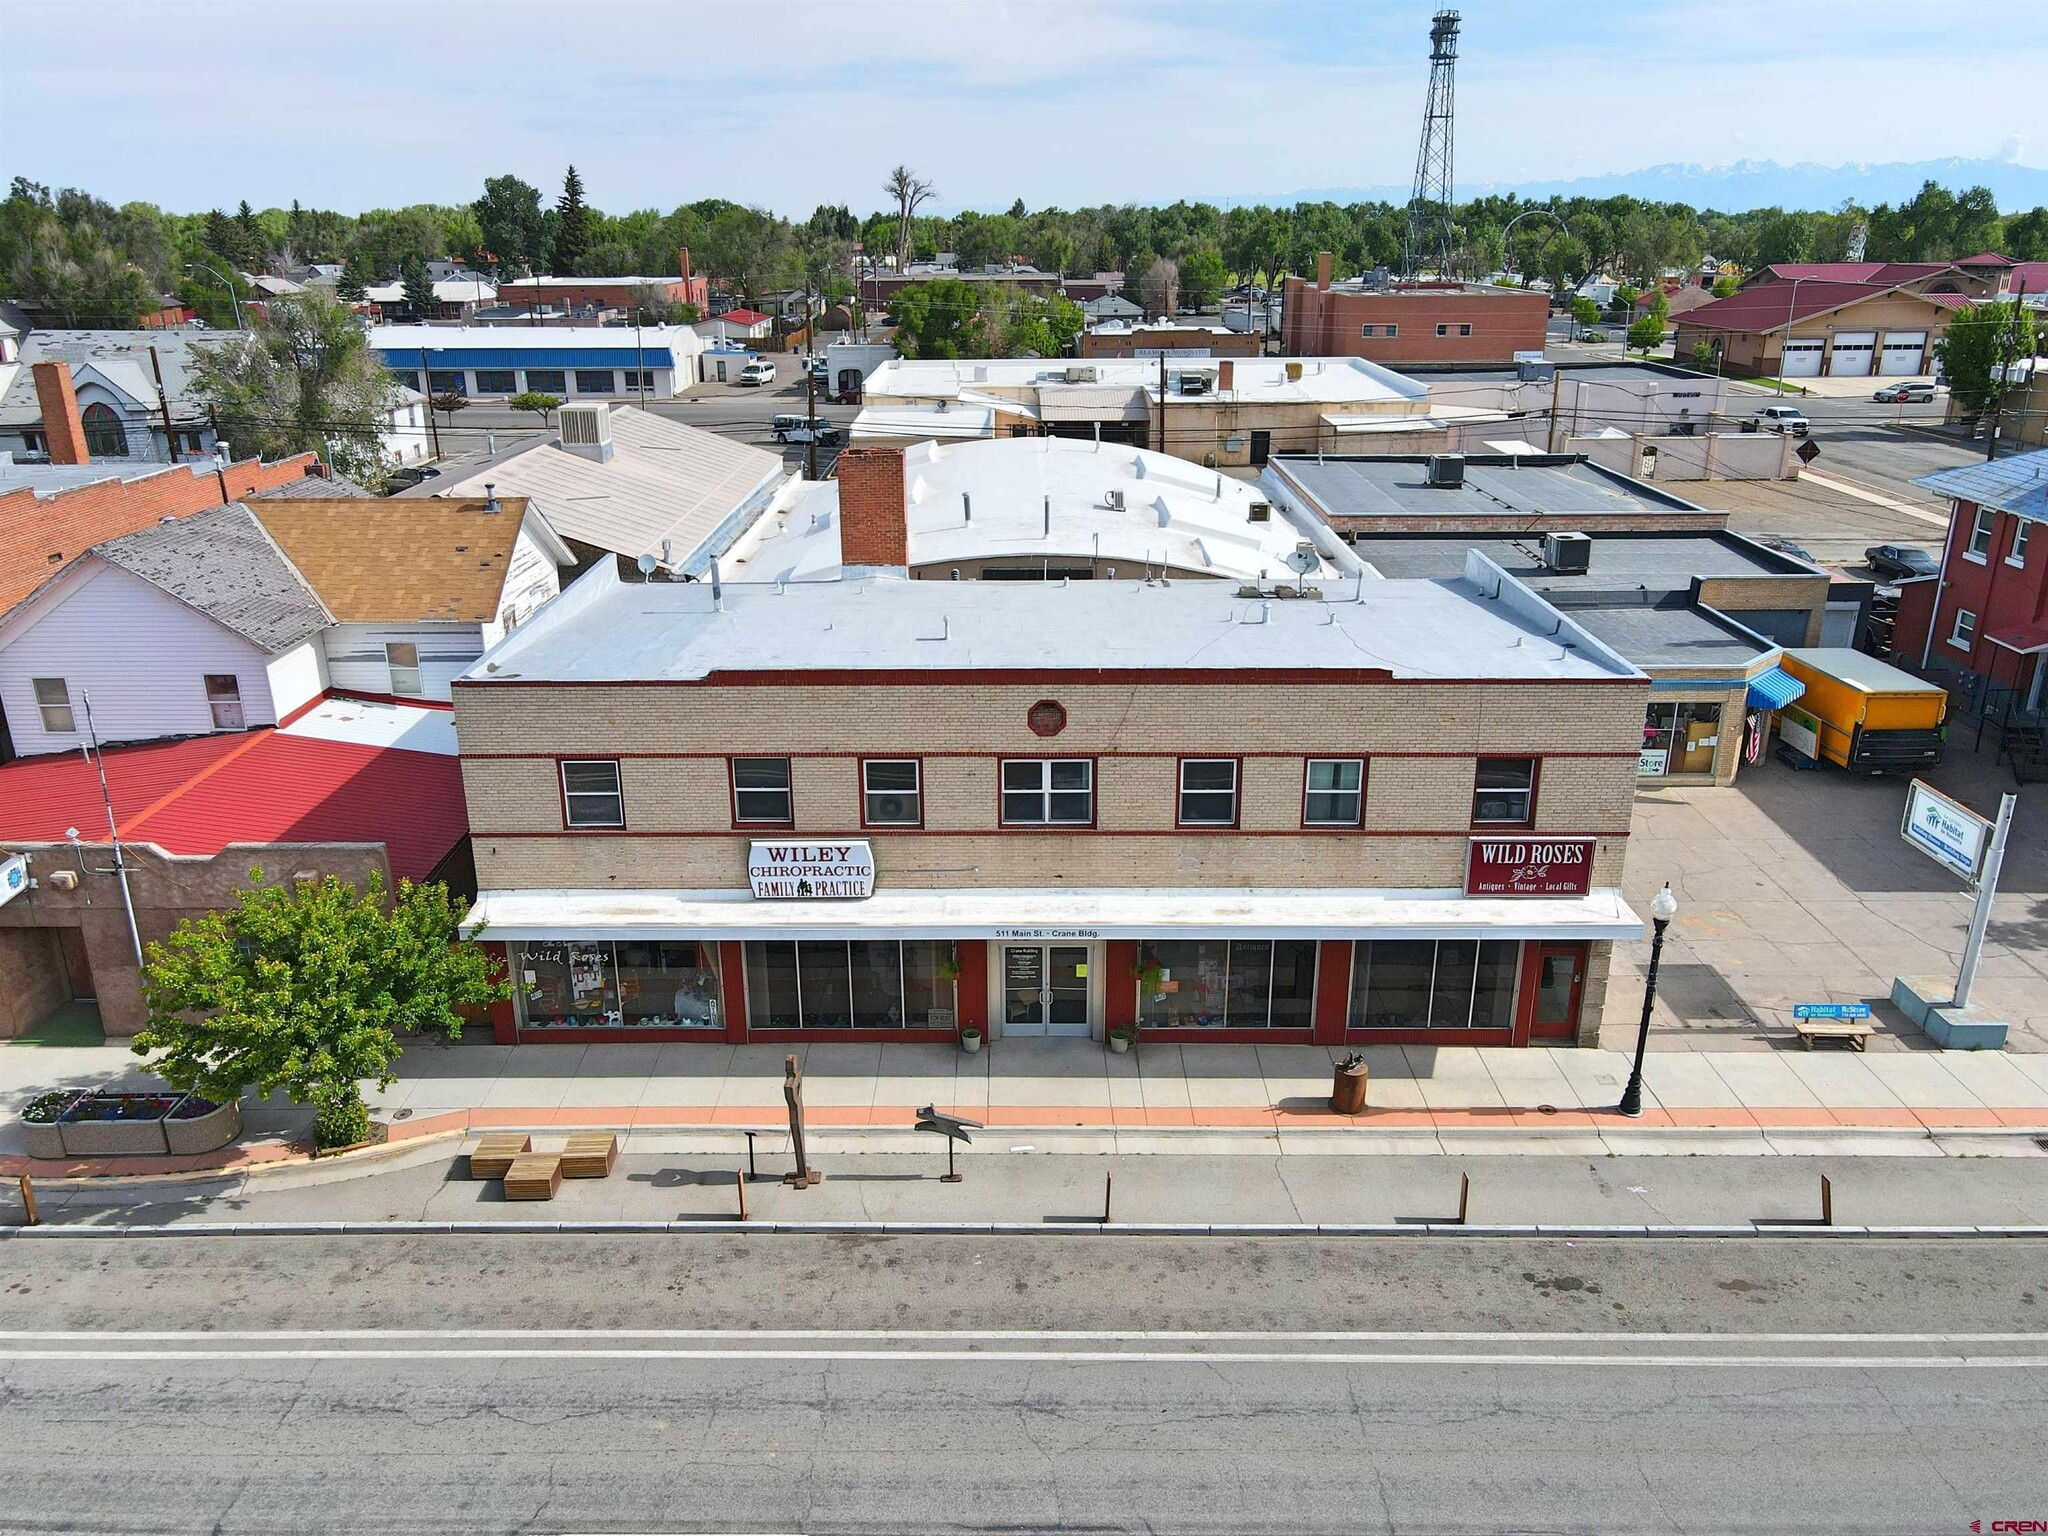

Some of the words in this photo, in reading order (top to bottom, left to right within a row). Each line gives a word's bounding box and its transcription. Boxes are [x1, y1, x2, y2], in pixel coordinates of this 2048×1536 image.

[1640, 758, 1663, 767] Store
[1941, 819, 1964, 840] Habitat
[767, 847, 851, 862] WILEY
[1482, 844, 1526, 864] WILD
[1530, 844, 1584, 864] ROSES
[750, 866, 871, 877] CHIROPRACTIC
[758, 881, 794, 896] FAMILY
[815, 881, 865, 896] PRACTICE
[1478, 882, 1505, 892] Antiques
[1514, 882, 1537, 892] Vintage
[1545, 882, 1561, 891] Local
[1563, 882, 1578, 891] Gifts
[1079, 930, 1100, 938] Bldg.
[517, 951, 563, 964] Wild
[569, 951, 608, 964] Roses
